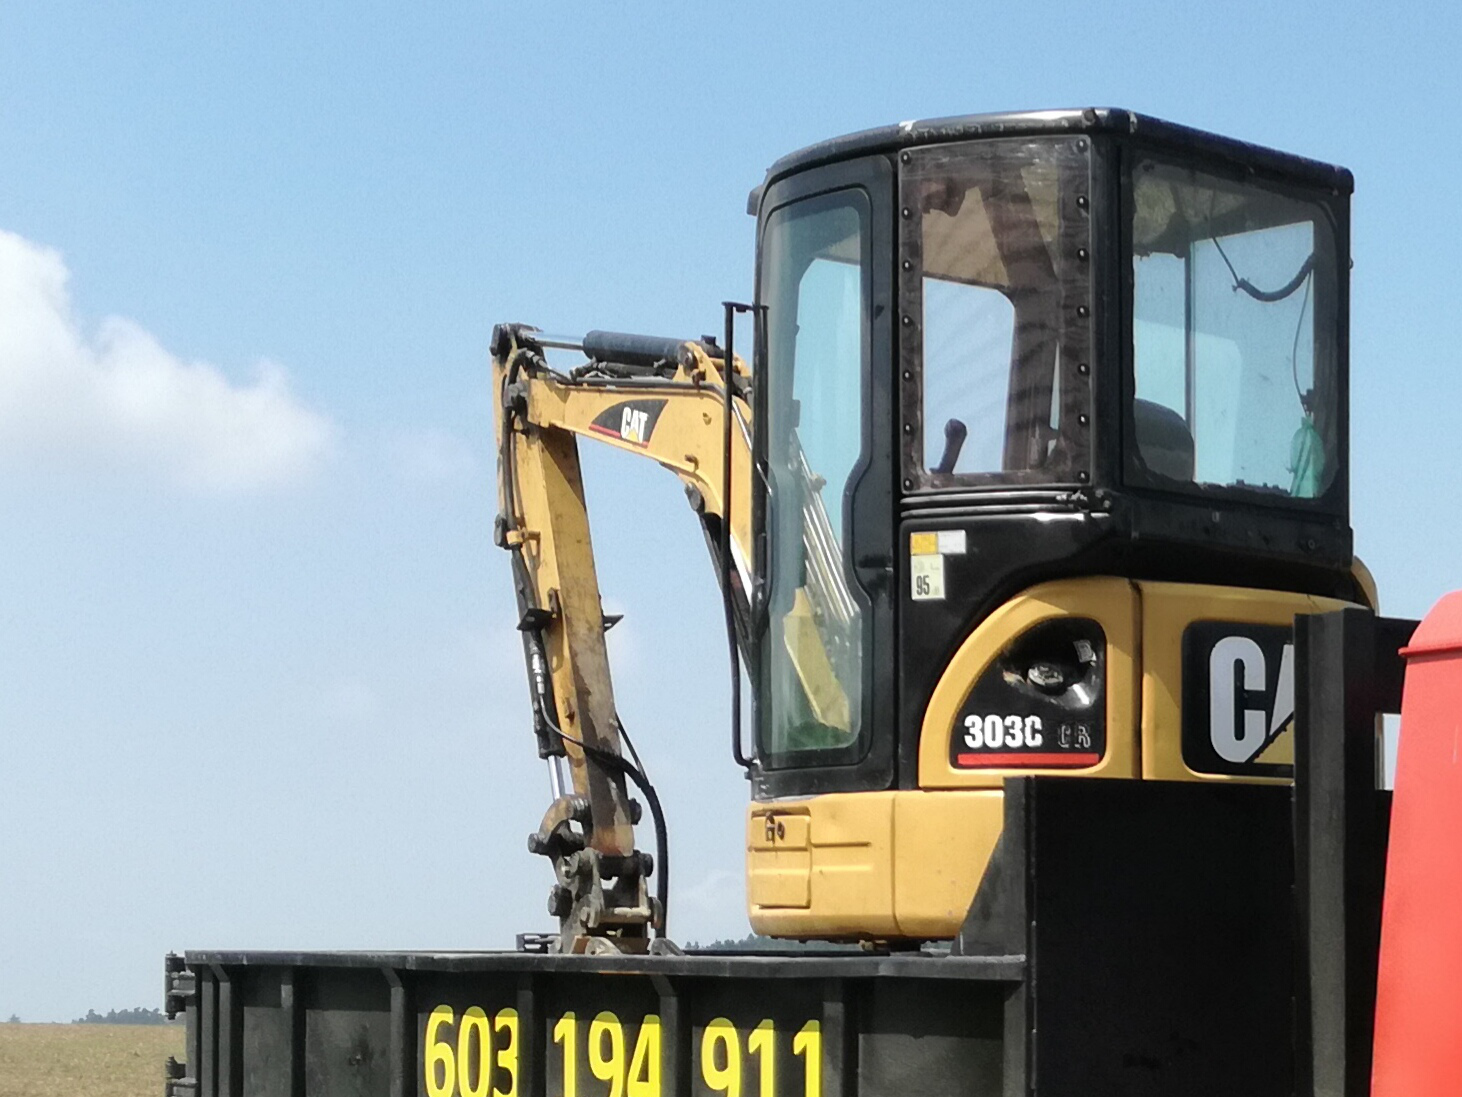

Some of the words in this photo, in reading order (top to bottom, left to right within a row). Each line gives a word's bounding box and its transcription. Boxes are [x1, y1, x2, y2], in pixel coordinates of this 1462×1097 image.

[620, 406, 649, 443] CAT
[916, 574, 930, 596] 95
[964, 714, 1043, 748] 303C
